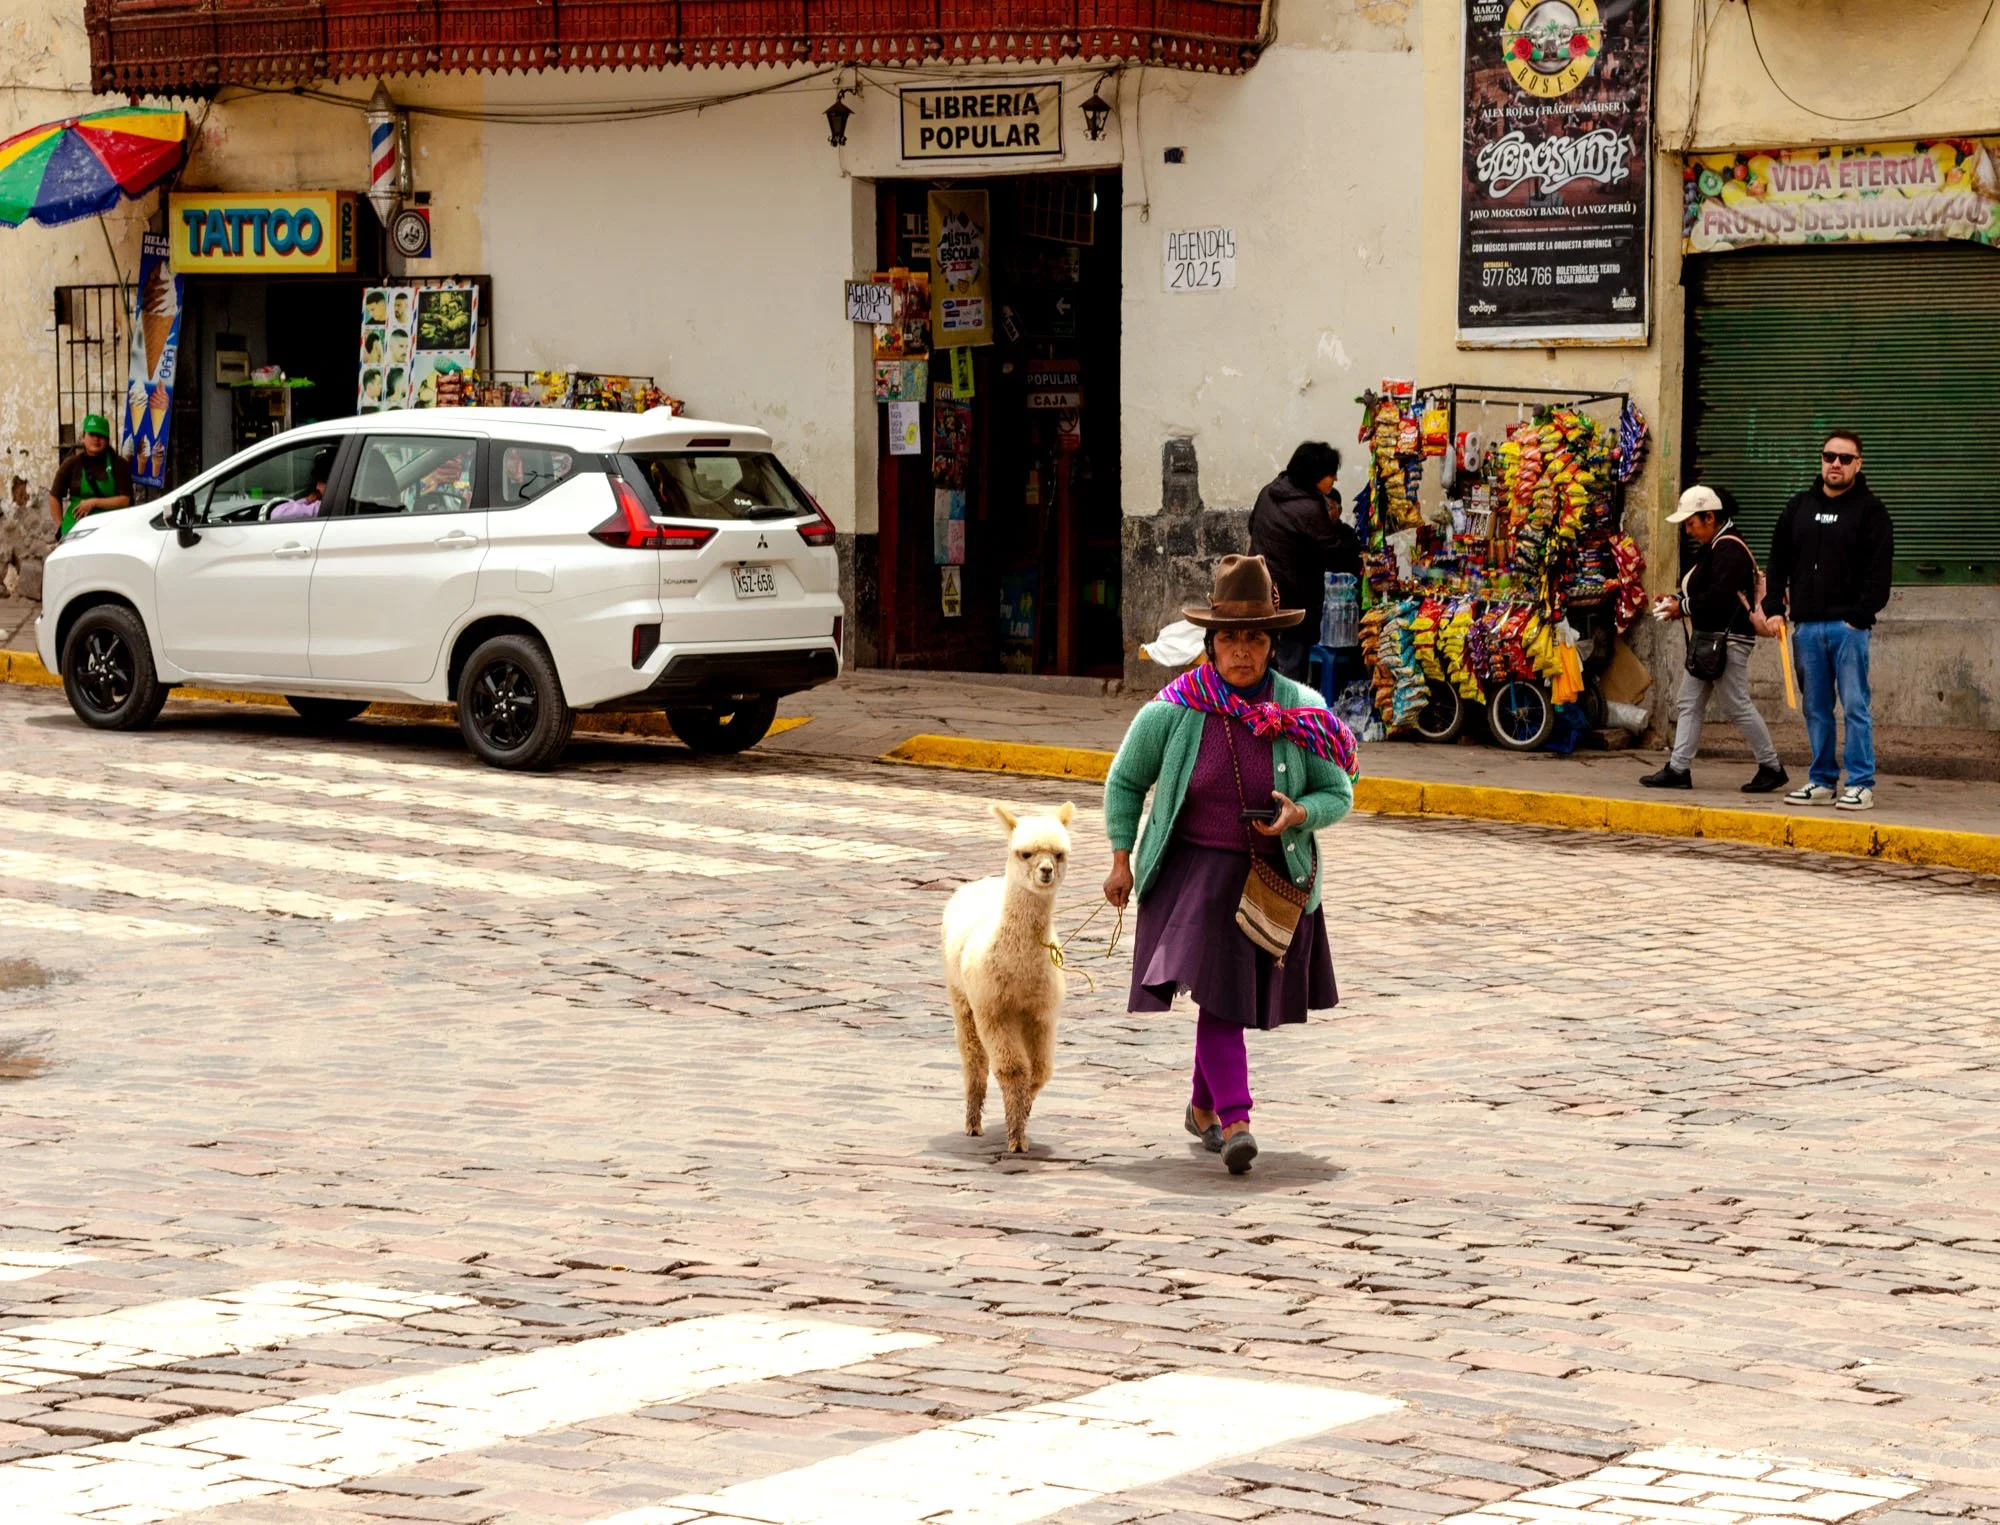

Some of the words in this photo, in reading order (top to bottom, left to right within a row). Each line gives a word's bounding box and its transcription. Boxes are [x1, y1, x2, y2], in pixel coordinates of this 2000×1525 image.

[1472, 4, 1504, 14] MARZO
[1517, 67, 1579, 94] ROSES
[920, 93, 1040, 120] LIBRERIA
[1482, 108, 1504, 118] ALEX
[1506, 106, 1534, 119] ROJAS
[1542, 103, 1574, 115] FRÁGIL
[920, 123, 1040, 150] POPULAR
[1476, 128, 1631, 198] AEROSMITH
[1771, 163, 1832, 192] VIDA
[1839, 158, 1937, 189] ETERNA
[1470, 209, 1490, 221] JAVO
[1491, 207, 1533, 218] MOSCOSO
[1540, 206, 1570, 216] BANDA
[1577, 205, 1588, 215] LA
[1589, 204, 1606, 214] VOZ
[1703, 205, 1798, 236] FRUTOS
[144, 235, 170, 246] HELA
[182, 207, 323, 257] TATTOO
[144, 245, 155, 254] DE
[941, 247, 979, 260] ESCOLAR
[1168, 229, 1236, 262] AGENDAS
[1472, 244, 1482, 252] CON
[1484, 242, 1508, 252] MÚSICOS
[1508, 242, 1536, 251] INVITADOS
[1538, 242, 1545, 250] DE
[1546, 241, 1553, 250] LA
[1554, 240, 1582, 250] ORQUESTA
[1171, 261, 1222, 288] 2025
[1482, 269, 1504, 286] 977
[1506, 268, 1528, 286] 634
[1531, 267, 1552, 286] 766
[1589, 264, 1599, 274] DEL
[1600, 264, 1620, 274] TEATRO
[848, 283, 891, 306] AGENDAS
[852, 302, 882, 322] 2025
[1027, 374, 1078, 385] POPULAR
[1034, 396, 1068, 406] CAJA
[736, 574, 774, 593] X5Z-658
